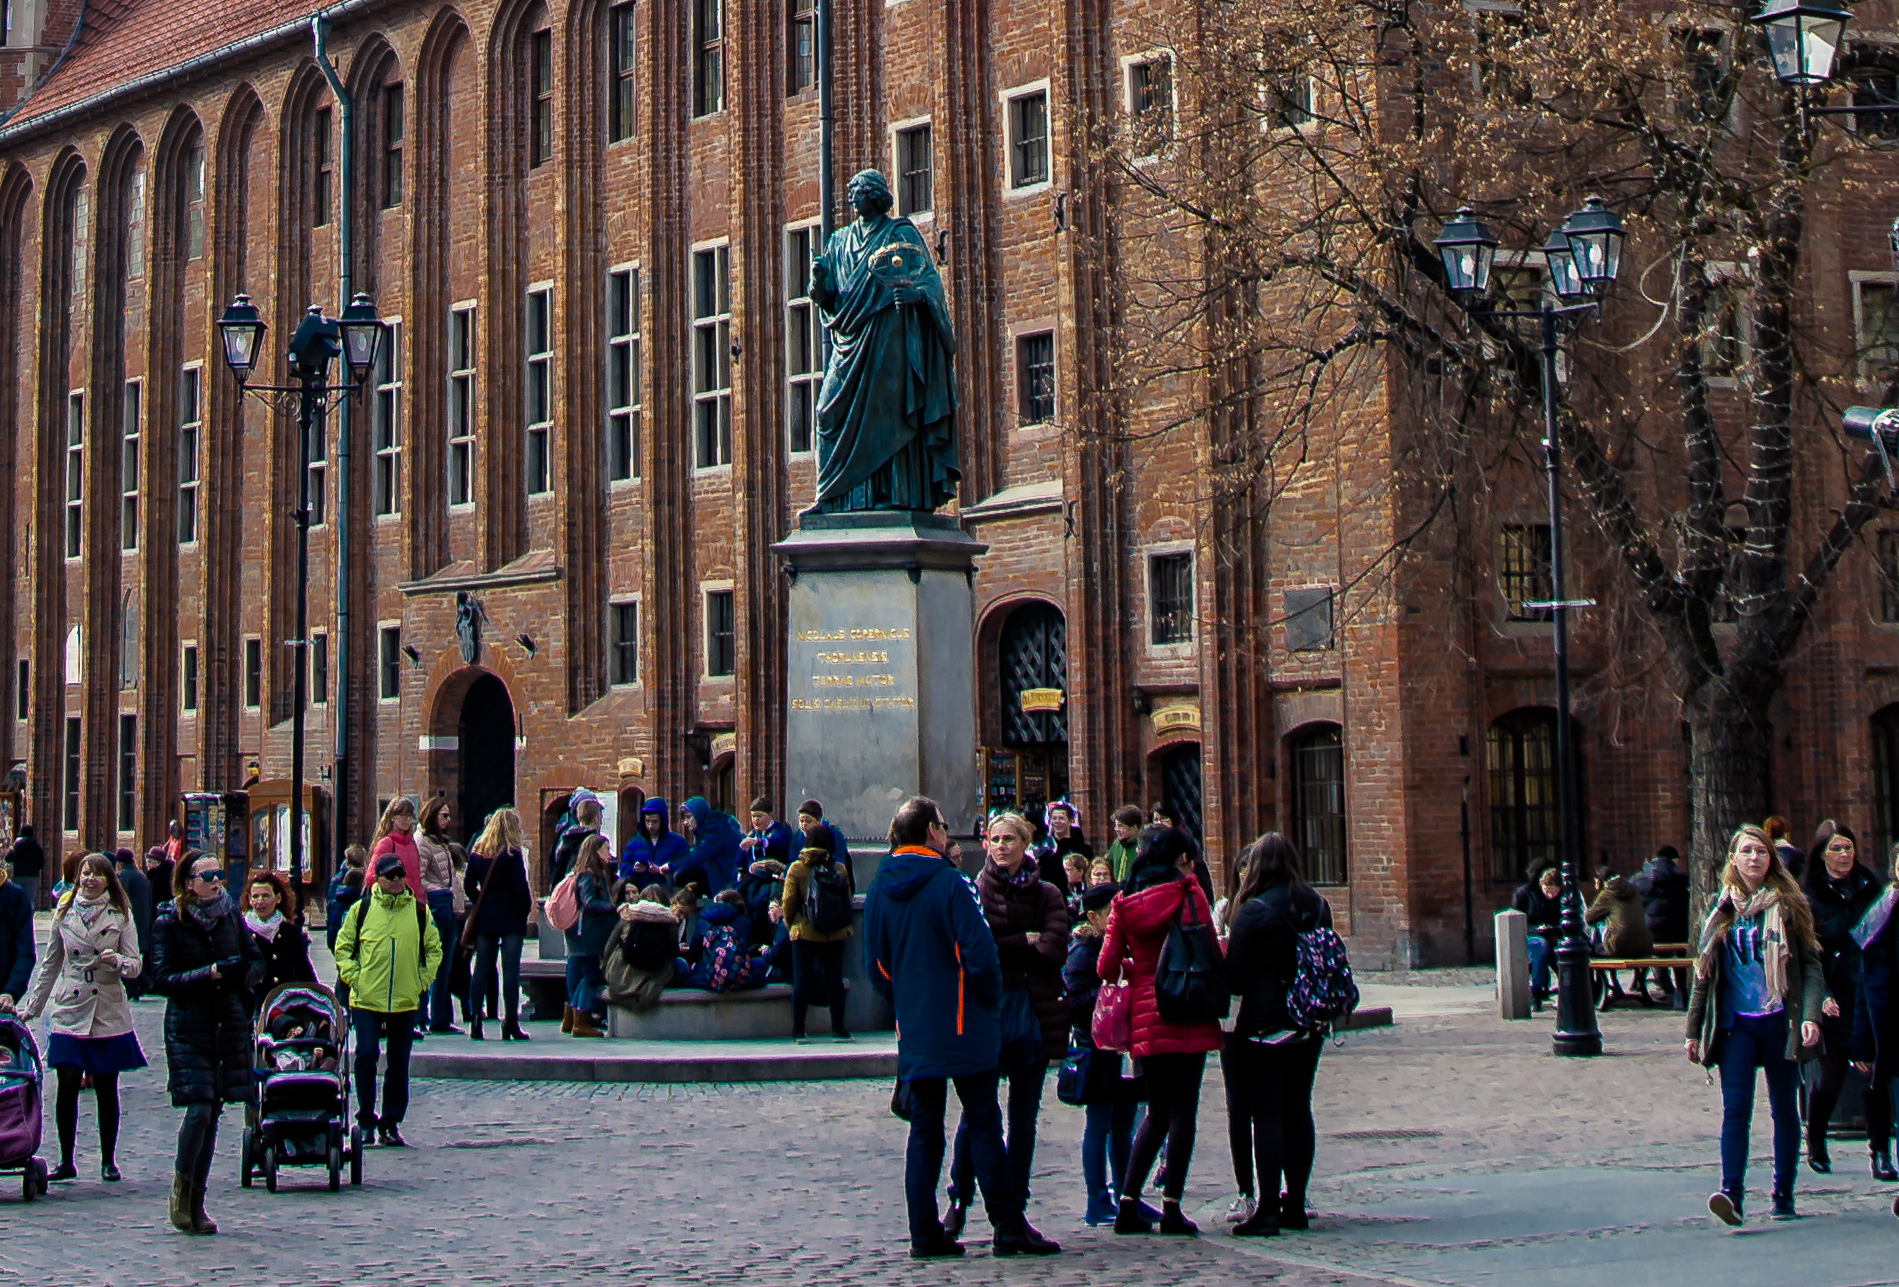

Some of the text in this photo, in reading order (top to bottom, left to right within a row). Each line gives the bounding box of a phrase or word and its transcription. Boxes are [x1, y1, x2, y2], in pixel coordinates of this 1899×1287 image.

[796, 627, 911, 642] NICOLAUS COPERNICUS
[816, 650, 889, 664] THORUNENSIS
[811, 674, 895, 687] TERRAE MOTOR
[790, 698, 821, 711] SOLIS
[873, 696, 915, 710] STATOR
